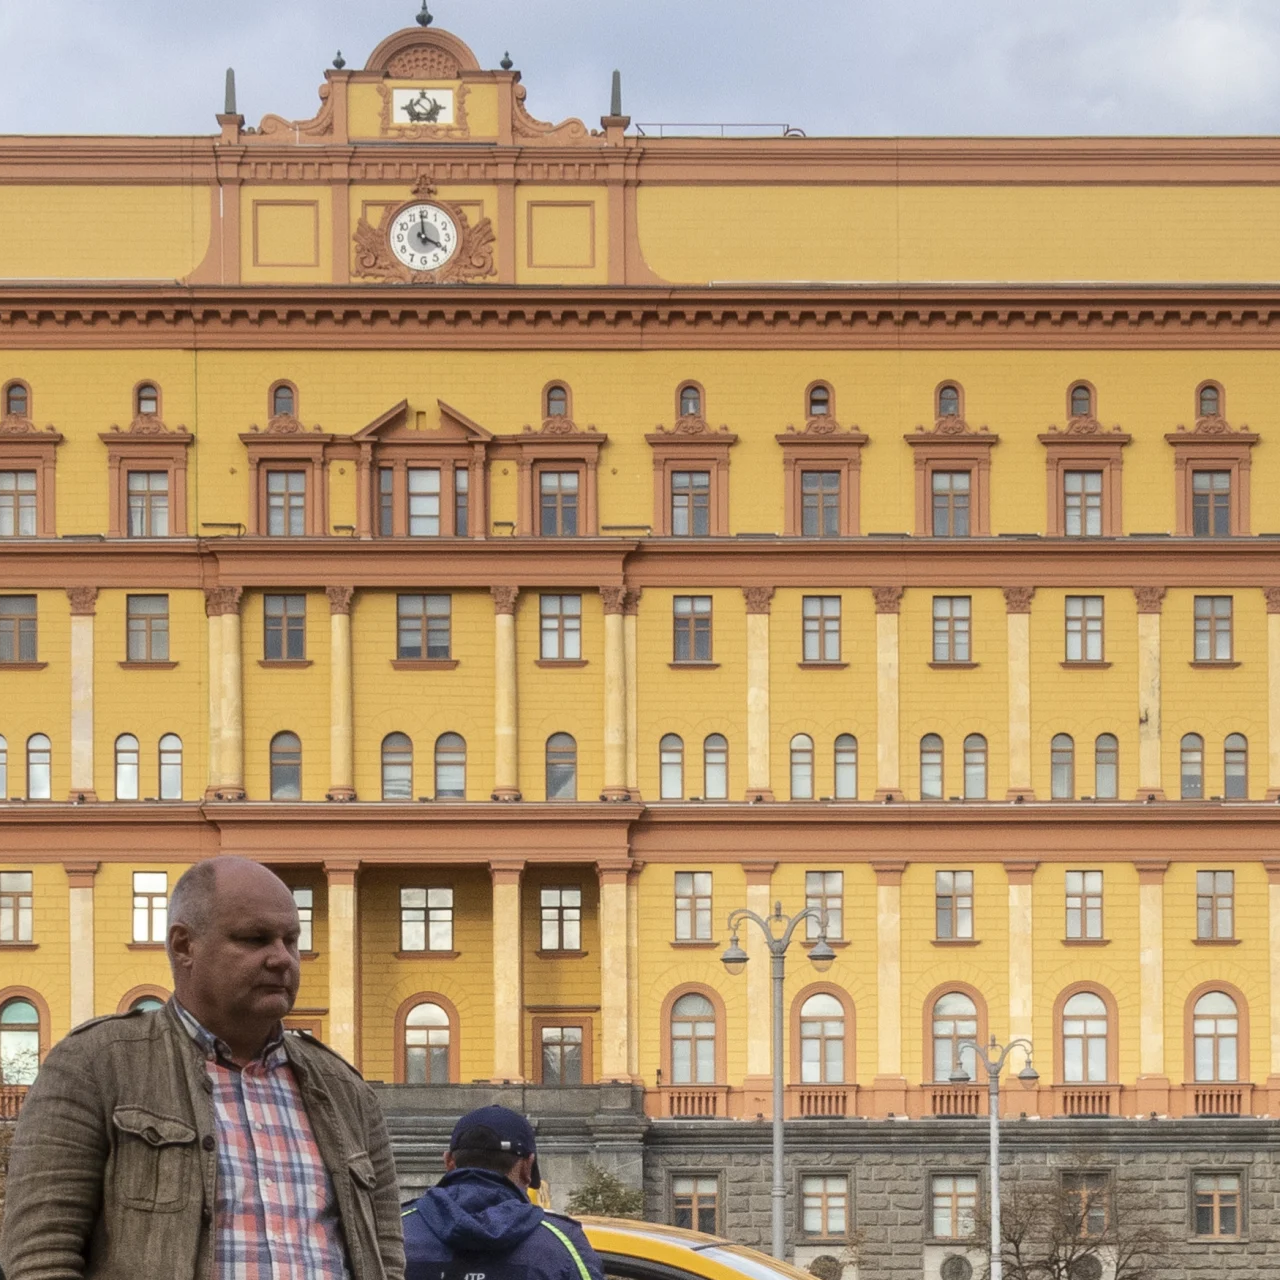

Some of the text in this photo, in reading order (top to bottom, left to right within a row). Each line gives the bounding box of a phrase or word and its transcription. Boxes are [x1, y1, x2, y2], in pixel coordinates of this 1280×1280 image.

[409, 213, 415, 222] 11
[400, 222, 409, 231] 10
[441, 221, 447, 231] 2
[396, 233, 404, 242] 9
[444, 233, 451, 242] 3
[400, 245, 407, 254] 8
[409, 253, 415, 262] 7
[420, 256, 428, 265] 6
[432, 253, 439, 262] 5
